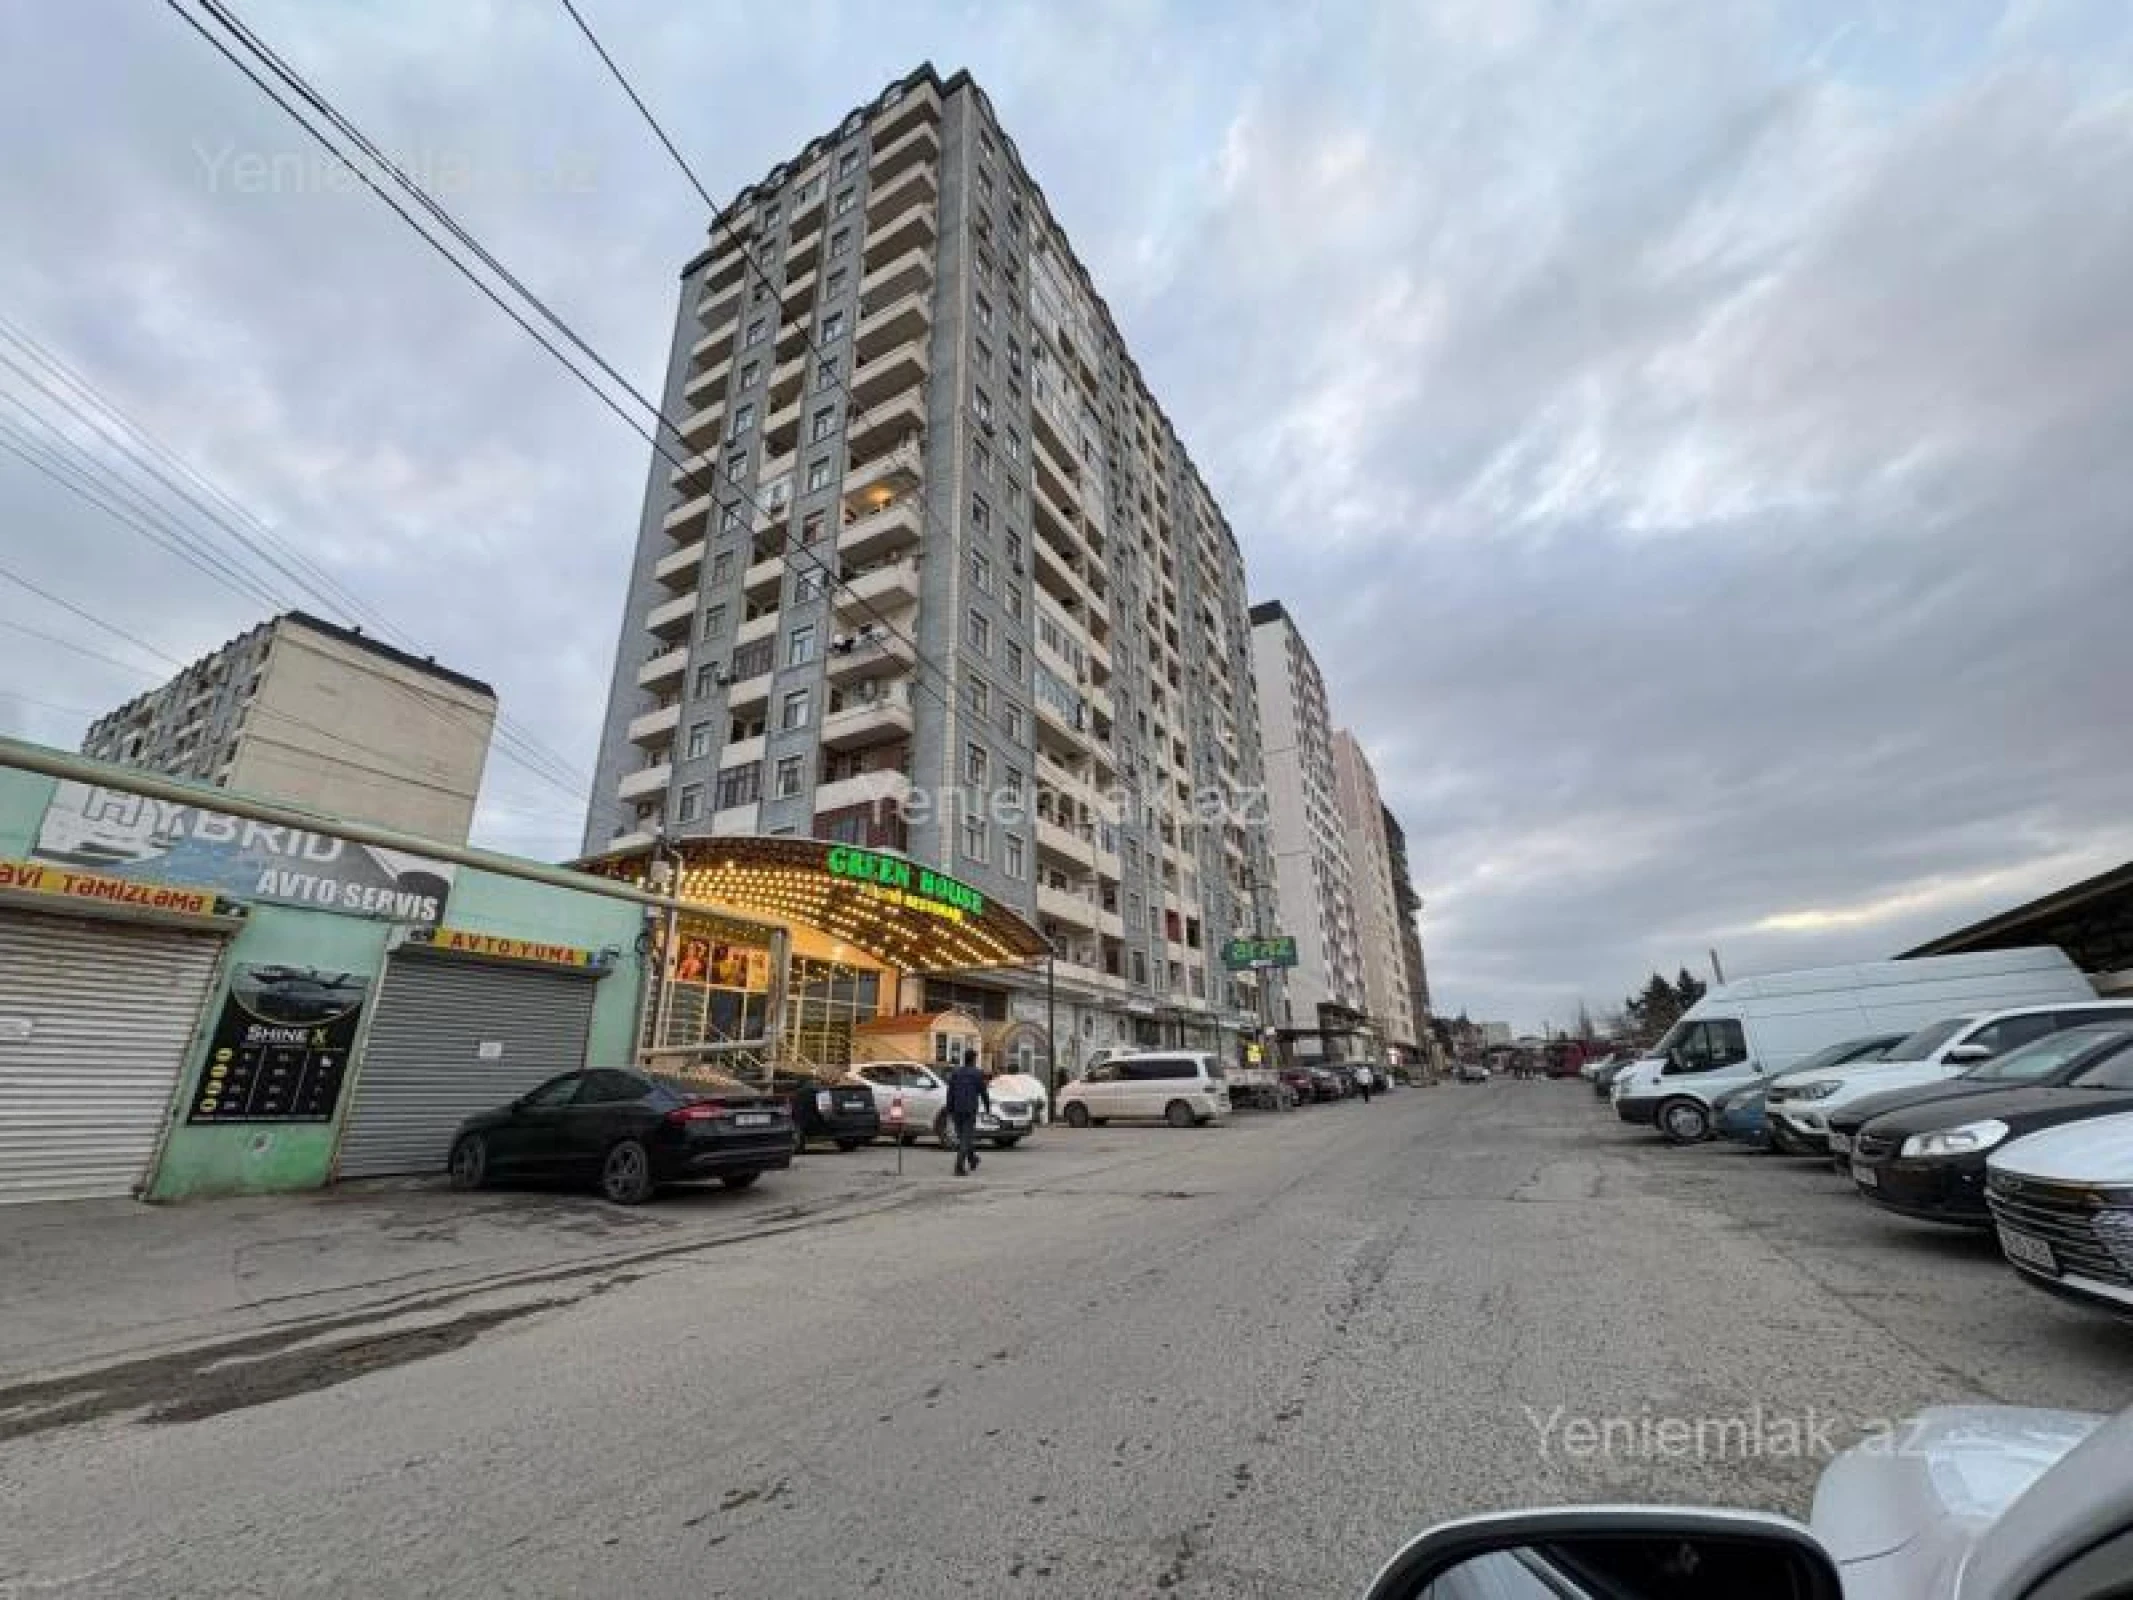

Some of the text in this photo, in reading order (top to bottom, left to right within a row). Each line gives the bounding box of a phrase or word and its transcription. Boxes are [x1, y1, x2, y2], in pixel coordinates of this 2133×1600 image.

[256, 868, 438, 921] AVTO SERVIS
[451, 932, 511, 953] AVTO
